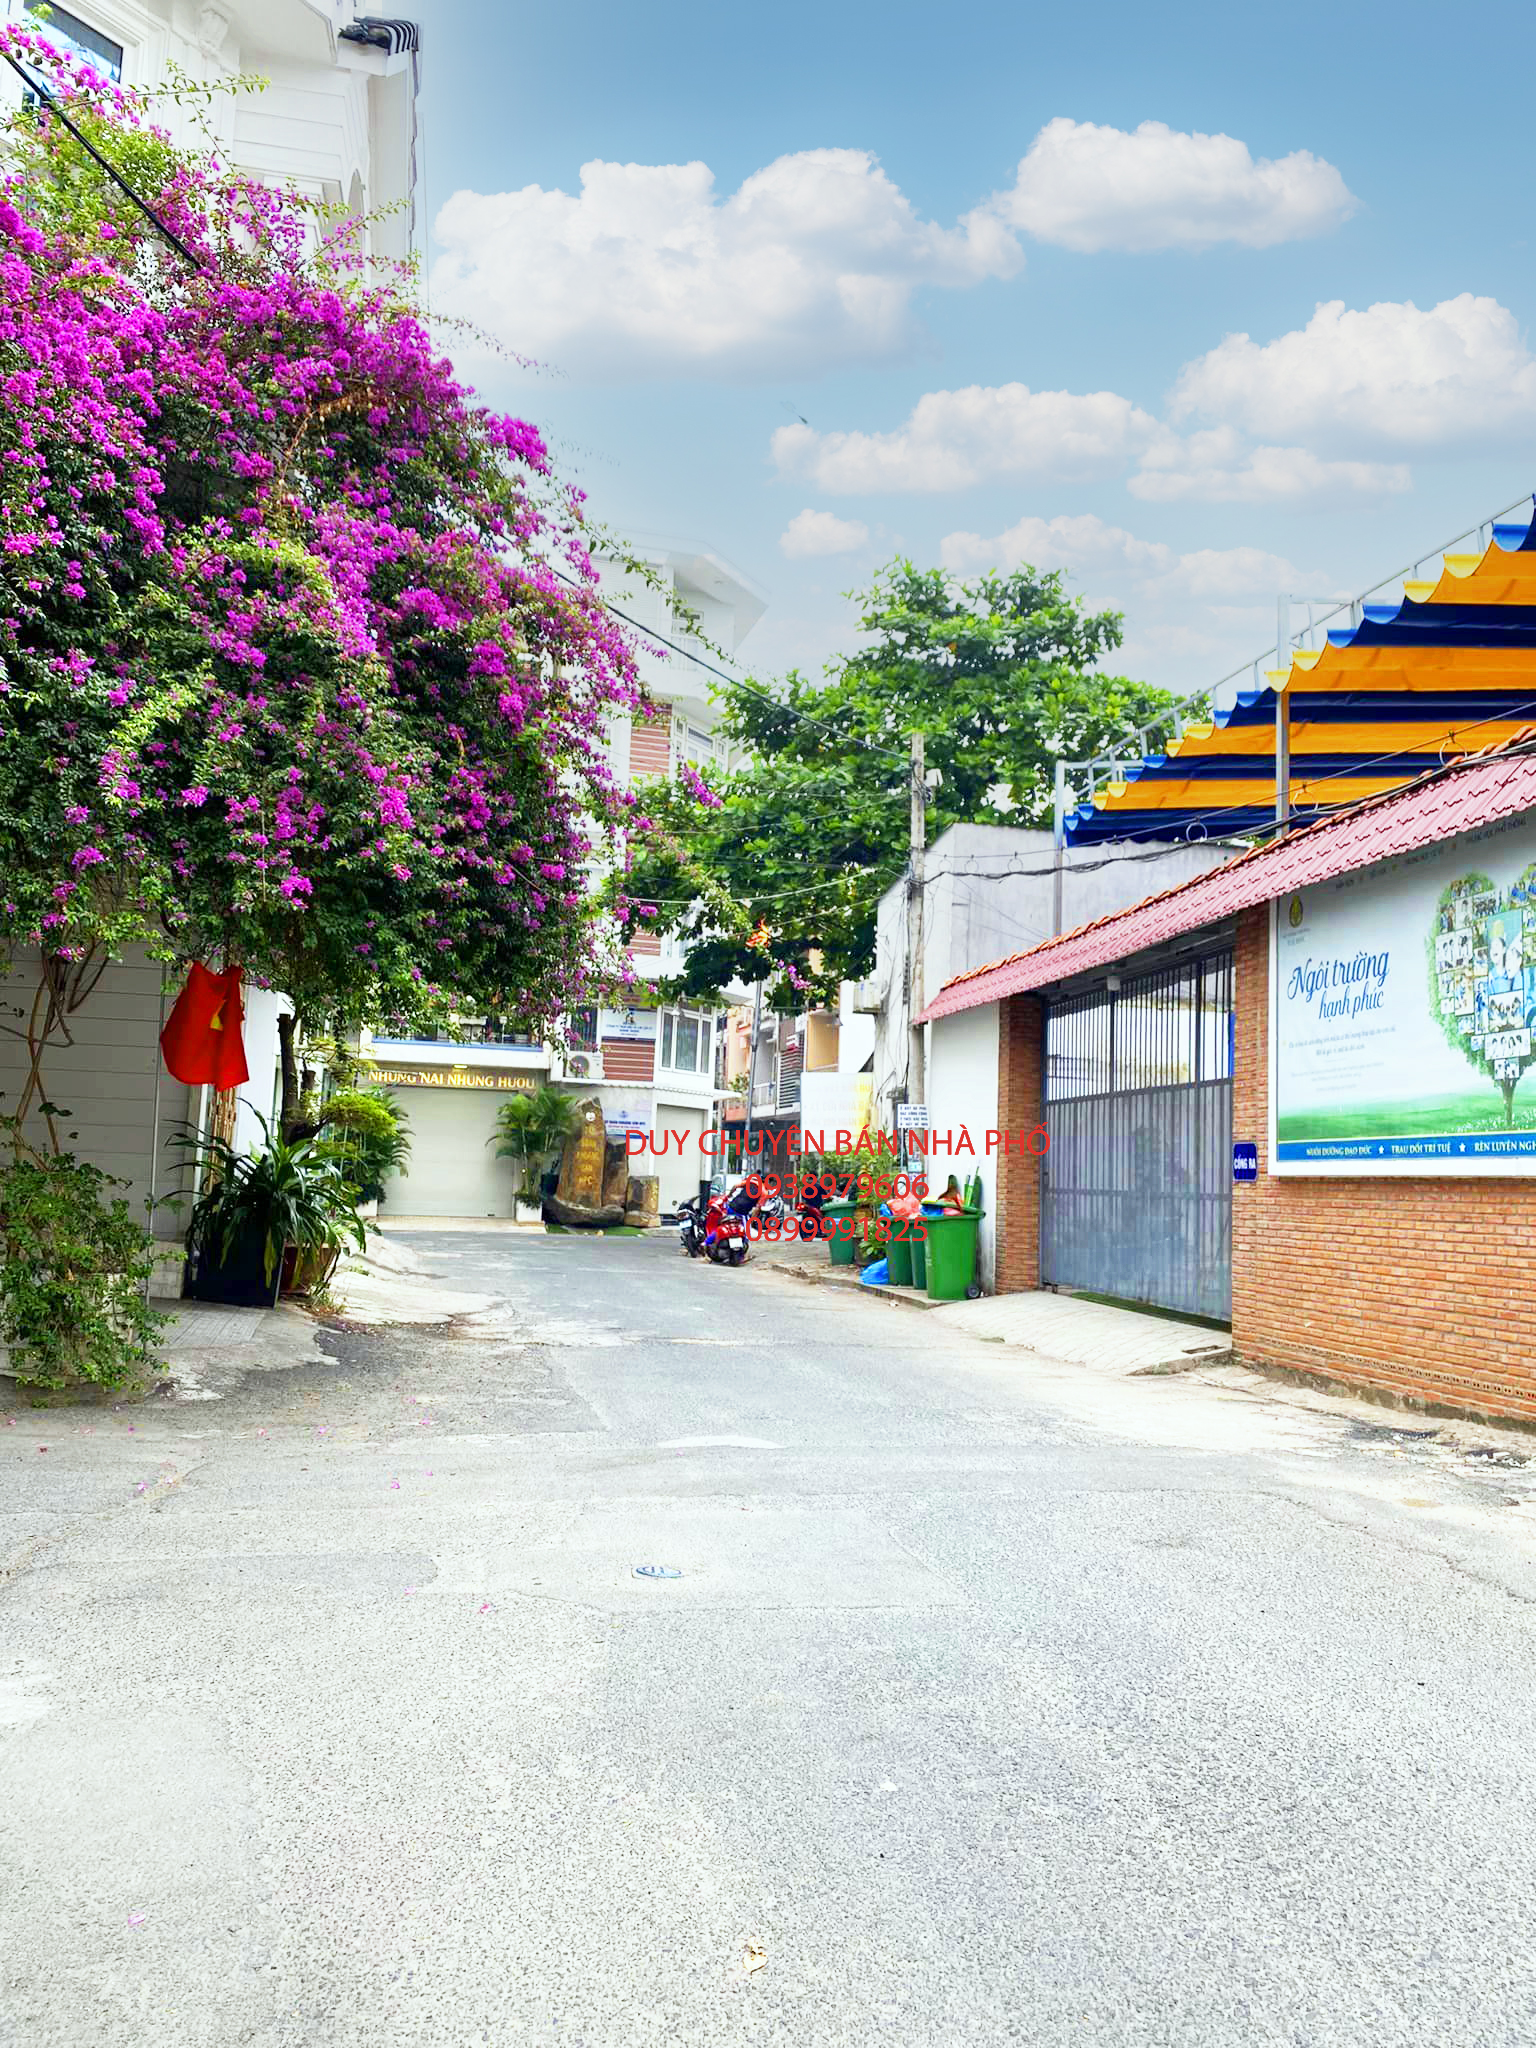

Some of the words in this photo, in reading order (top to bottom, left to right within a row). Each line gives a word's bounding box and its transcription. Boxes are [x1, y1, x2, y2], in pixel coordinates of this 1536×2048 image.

[1287, 958, 1330, 1003] Ngôi
[1333, 950, 1390, 988] trường
[1318, 985, 1350, 1022] hạnh
[1352, 981, 1385, 1019] phúc
[419, 1072, 444, 1085] NAI
[447, 1073, 494, 1087] NHUNG
